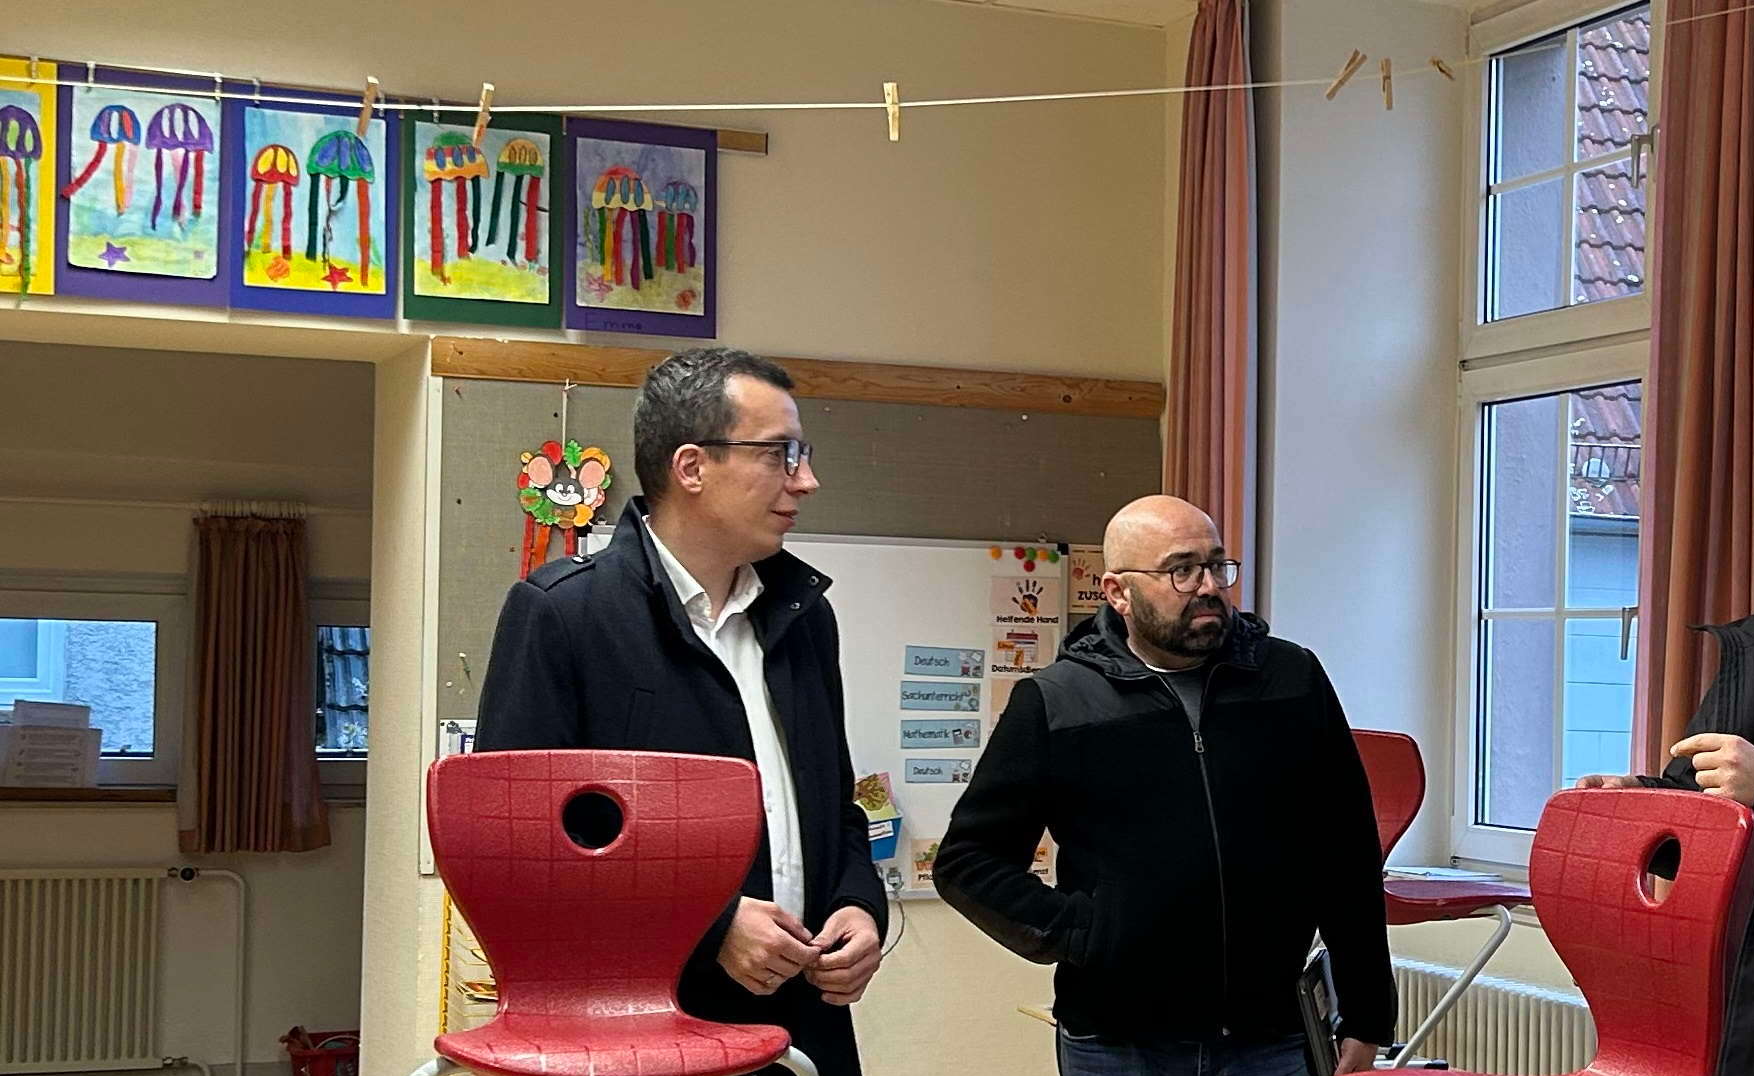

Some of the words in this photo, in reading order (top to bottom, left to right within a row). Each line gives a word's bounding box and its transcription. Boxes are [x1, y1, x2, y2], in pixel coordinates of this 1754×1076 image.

[996, 615, 1035, 624] Helfende
[1036, 615, 1059, 624] Hand
[914, 655, 950, 667] Deutsch
[903, 728, 950, 739] Mathematik
[913, 766, 943, 776] Deutsch
